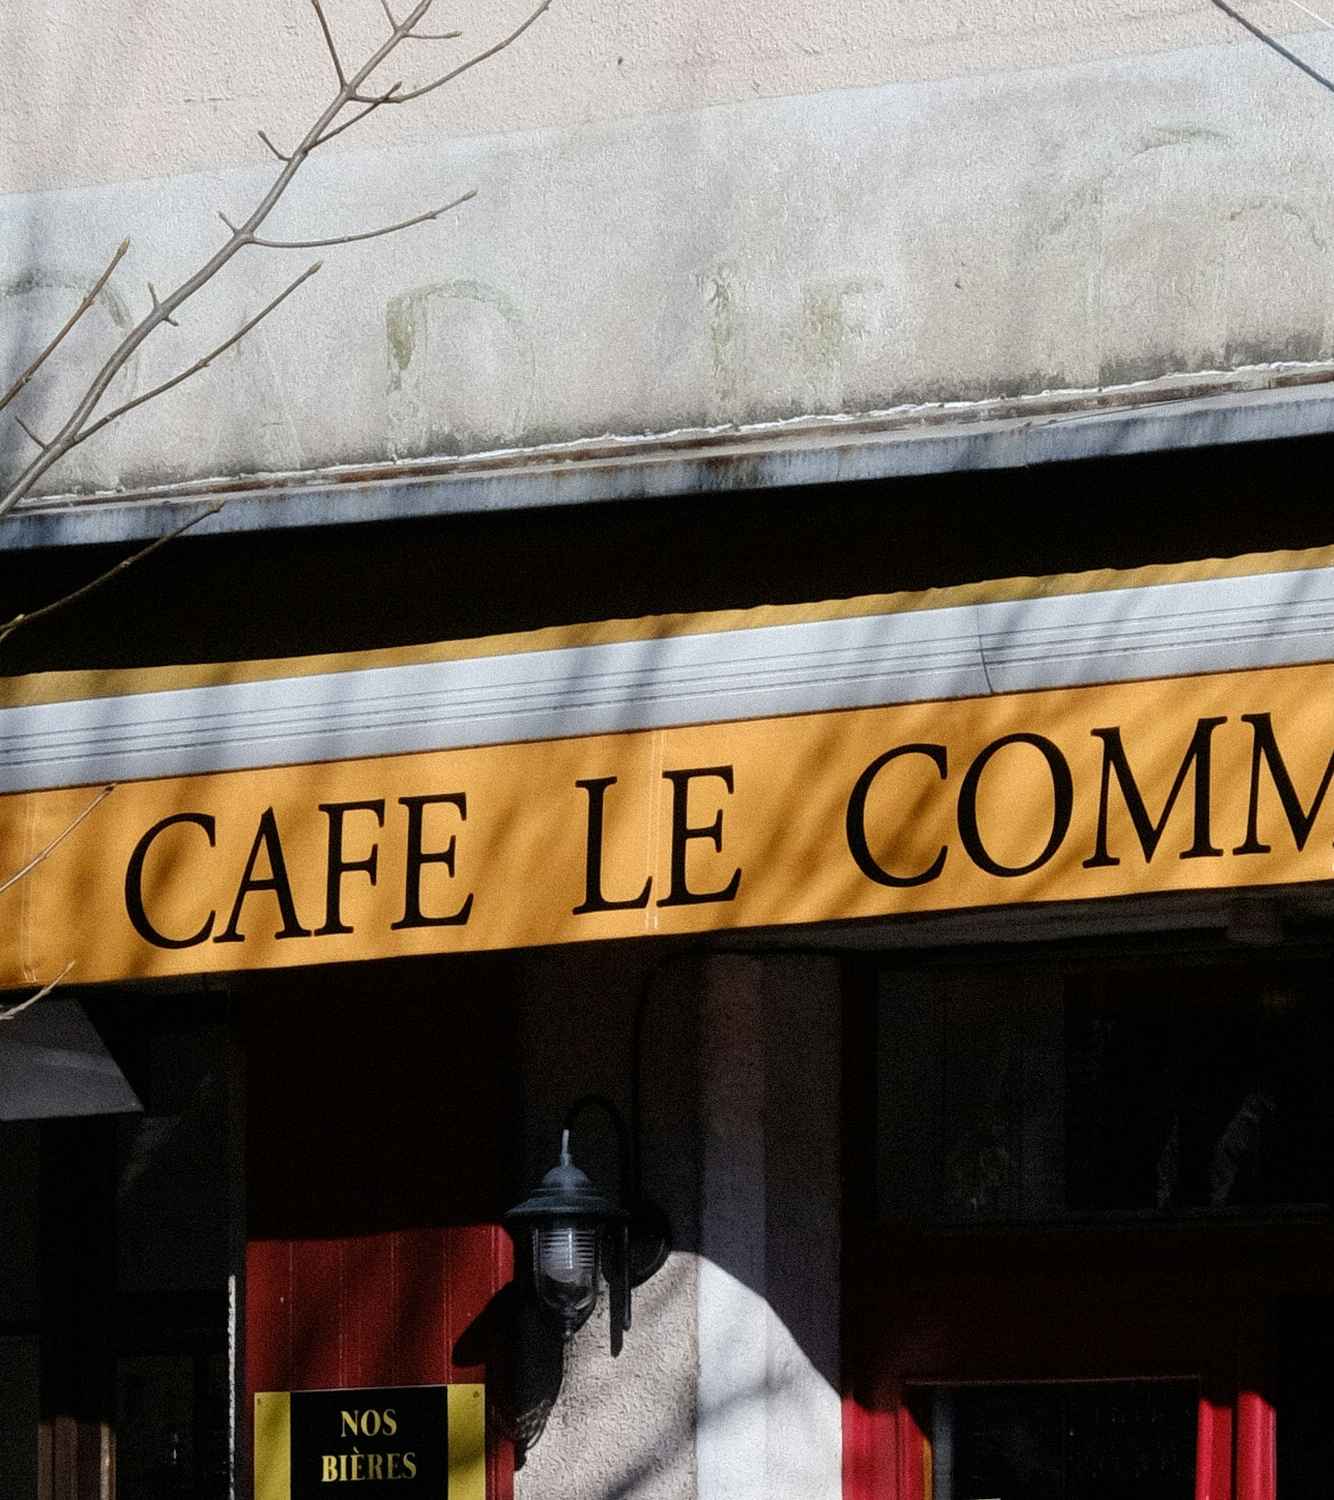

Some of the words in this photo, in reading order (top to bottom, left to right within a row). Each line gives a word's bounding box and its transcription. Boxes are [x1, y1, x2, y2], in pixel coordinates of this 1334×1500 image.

[124, 791, 476, 951] CAFE
[572, 765, 744, 916] LE
[340, 1408, 397, 1438] NOS
[321, 1446, 417, 1482] BIÈRES
